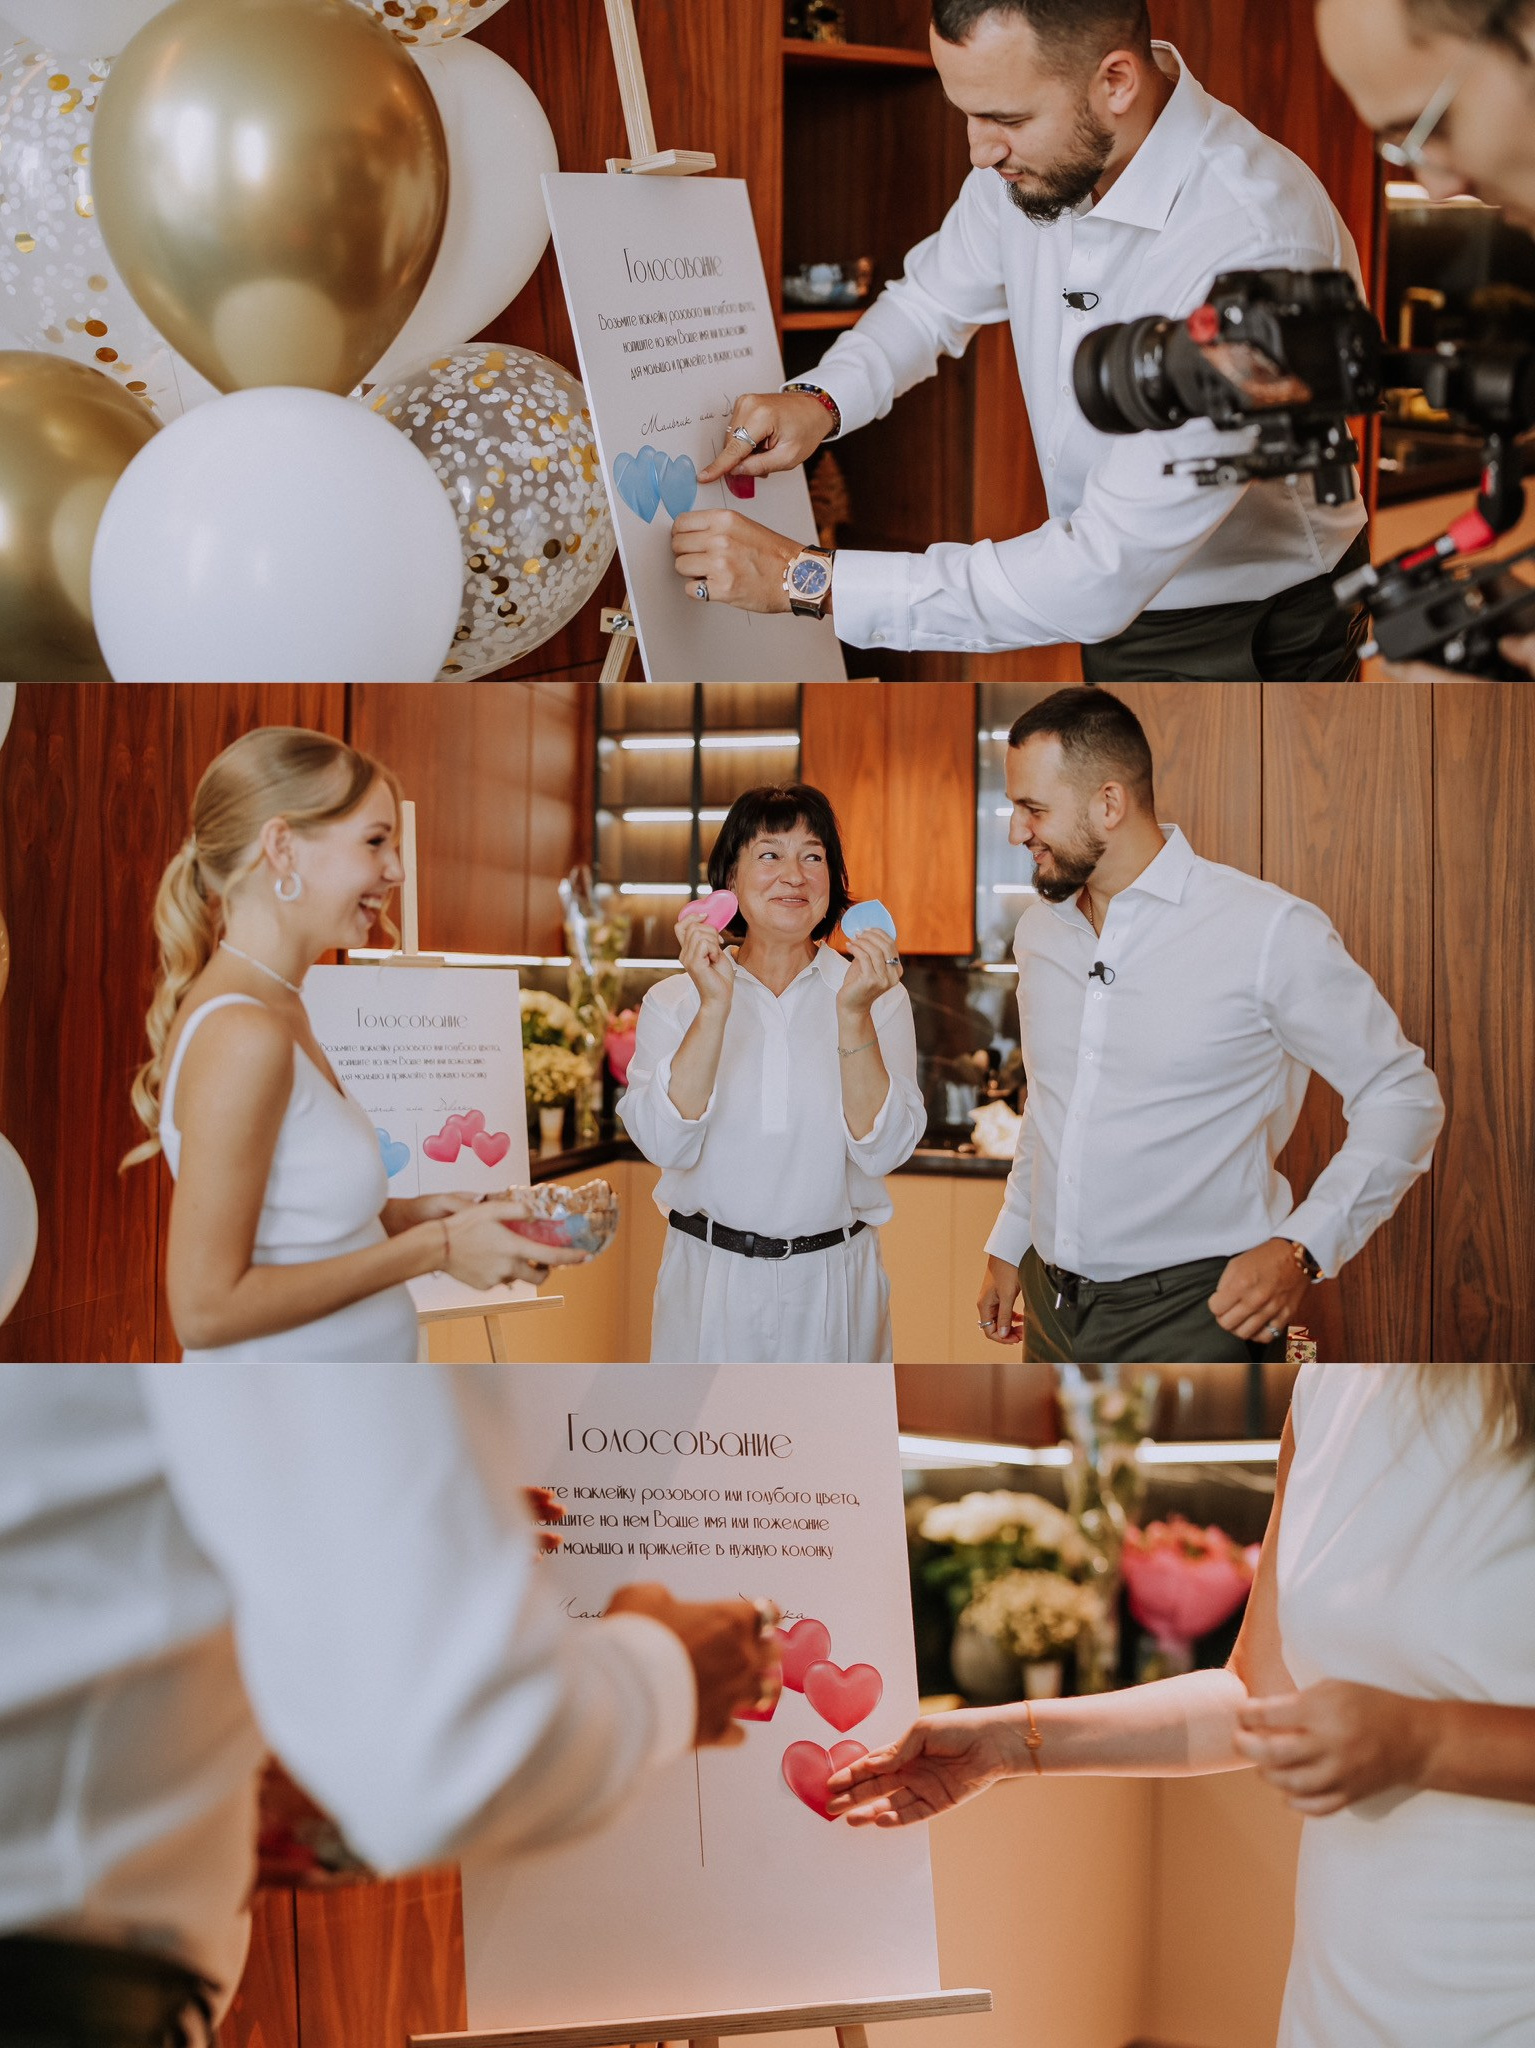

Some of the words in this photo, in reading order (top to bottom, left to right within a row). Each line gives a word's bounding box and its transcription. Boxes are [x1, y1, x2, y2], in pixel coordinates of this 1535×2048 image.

[622, 247, 724, 284] Голосование
[598, 313, 637, 330] Возьмите
[669, 307, 703, 326] розового
[622, 338, 655, 353] напишите
[655, 337, 665, 348] на
[677, 328, 698, 344] Ваше
[630, 366, 643, 381] для
[643, 361, 671, 376] малыша
[677, 353, 707, 374] приклейте
[641, 412, 692, 436] Мальчик
[700, 412, 714, 421] или
[357, 1008, 468, 1028] Голосование
[399, 1056, 421, 1067] Ваше
[567, 1412, 794, 1460] Голосование
[574, 1485, 637, 1503] наклейку
[641, 1488, 721, 1506] розового
[724, 1489, 743, 1502] или
[746, 1486, 812, 1506] голубого
[816, 1492, 861, 1507] цвета,
[600, 1514, 619, 1527] на
[623, 1514, 649, 1527] нем
[653, 1509, 700, 1528] Ваше
[704, 1516, 727, 1529] имя
[731, 1517, 749, 1529] или
[753, 1517, 830, 1531] пожелание
[563, 1542, 623, 1556] малыша
[628, 1542, 635, 1555] и
[639, 1541, 710, 1561] приклейте
[715, 1543, 725, 1556] в
[729, 1543, 778, 1559] нужную
[781, 1545, 834, 1560] колонку
